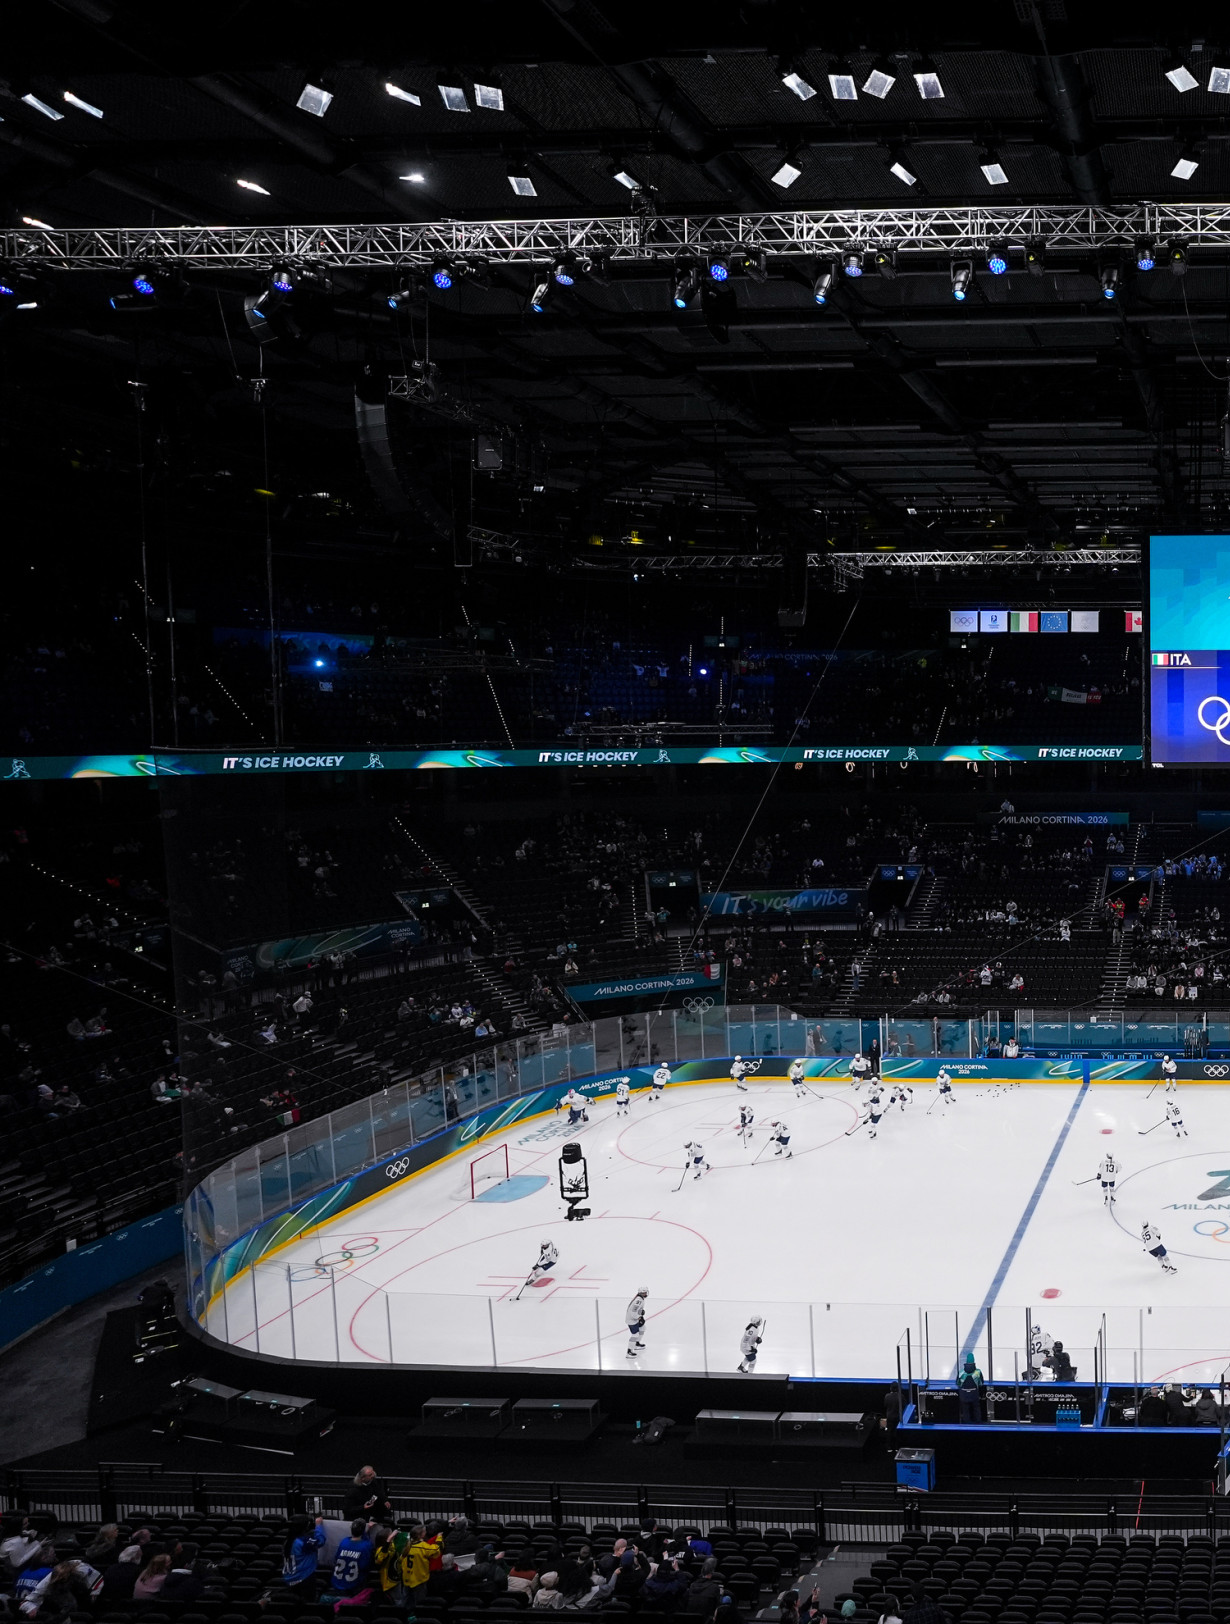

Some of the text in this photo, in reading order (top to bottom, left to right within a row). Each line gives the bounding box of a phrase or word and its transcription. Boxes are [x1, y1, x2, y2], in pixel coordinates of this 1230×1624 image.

[1170, 653, 1192, 666] ITA
[539, 751, 638, 762] IT'S ICE HOCKEY
[804, 749, 890, 759] IT'S ICE HOCKEY
[1038, 748, 1123, 757] IT'S ICE HOCKEY
[223, 756, 344, 769] IT'S ICE HOCKEY
[998, 816, 1108, 824] MILANO CORTINA 2026
[812, 889, 849, 907] vibe
[594, 978, 695, 996] MILANO CORTINA 2026
[656, 1071, 666, 1080] 22
[1172, 1107, 1181, 1116] 16
[1105, 1163, 1115, 1173] 13
[333, 1558, 359, 1582] 23
